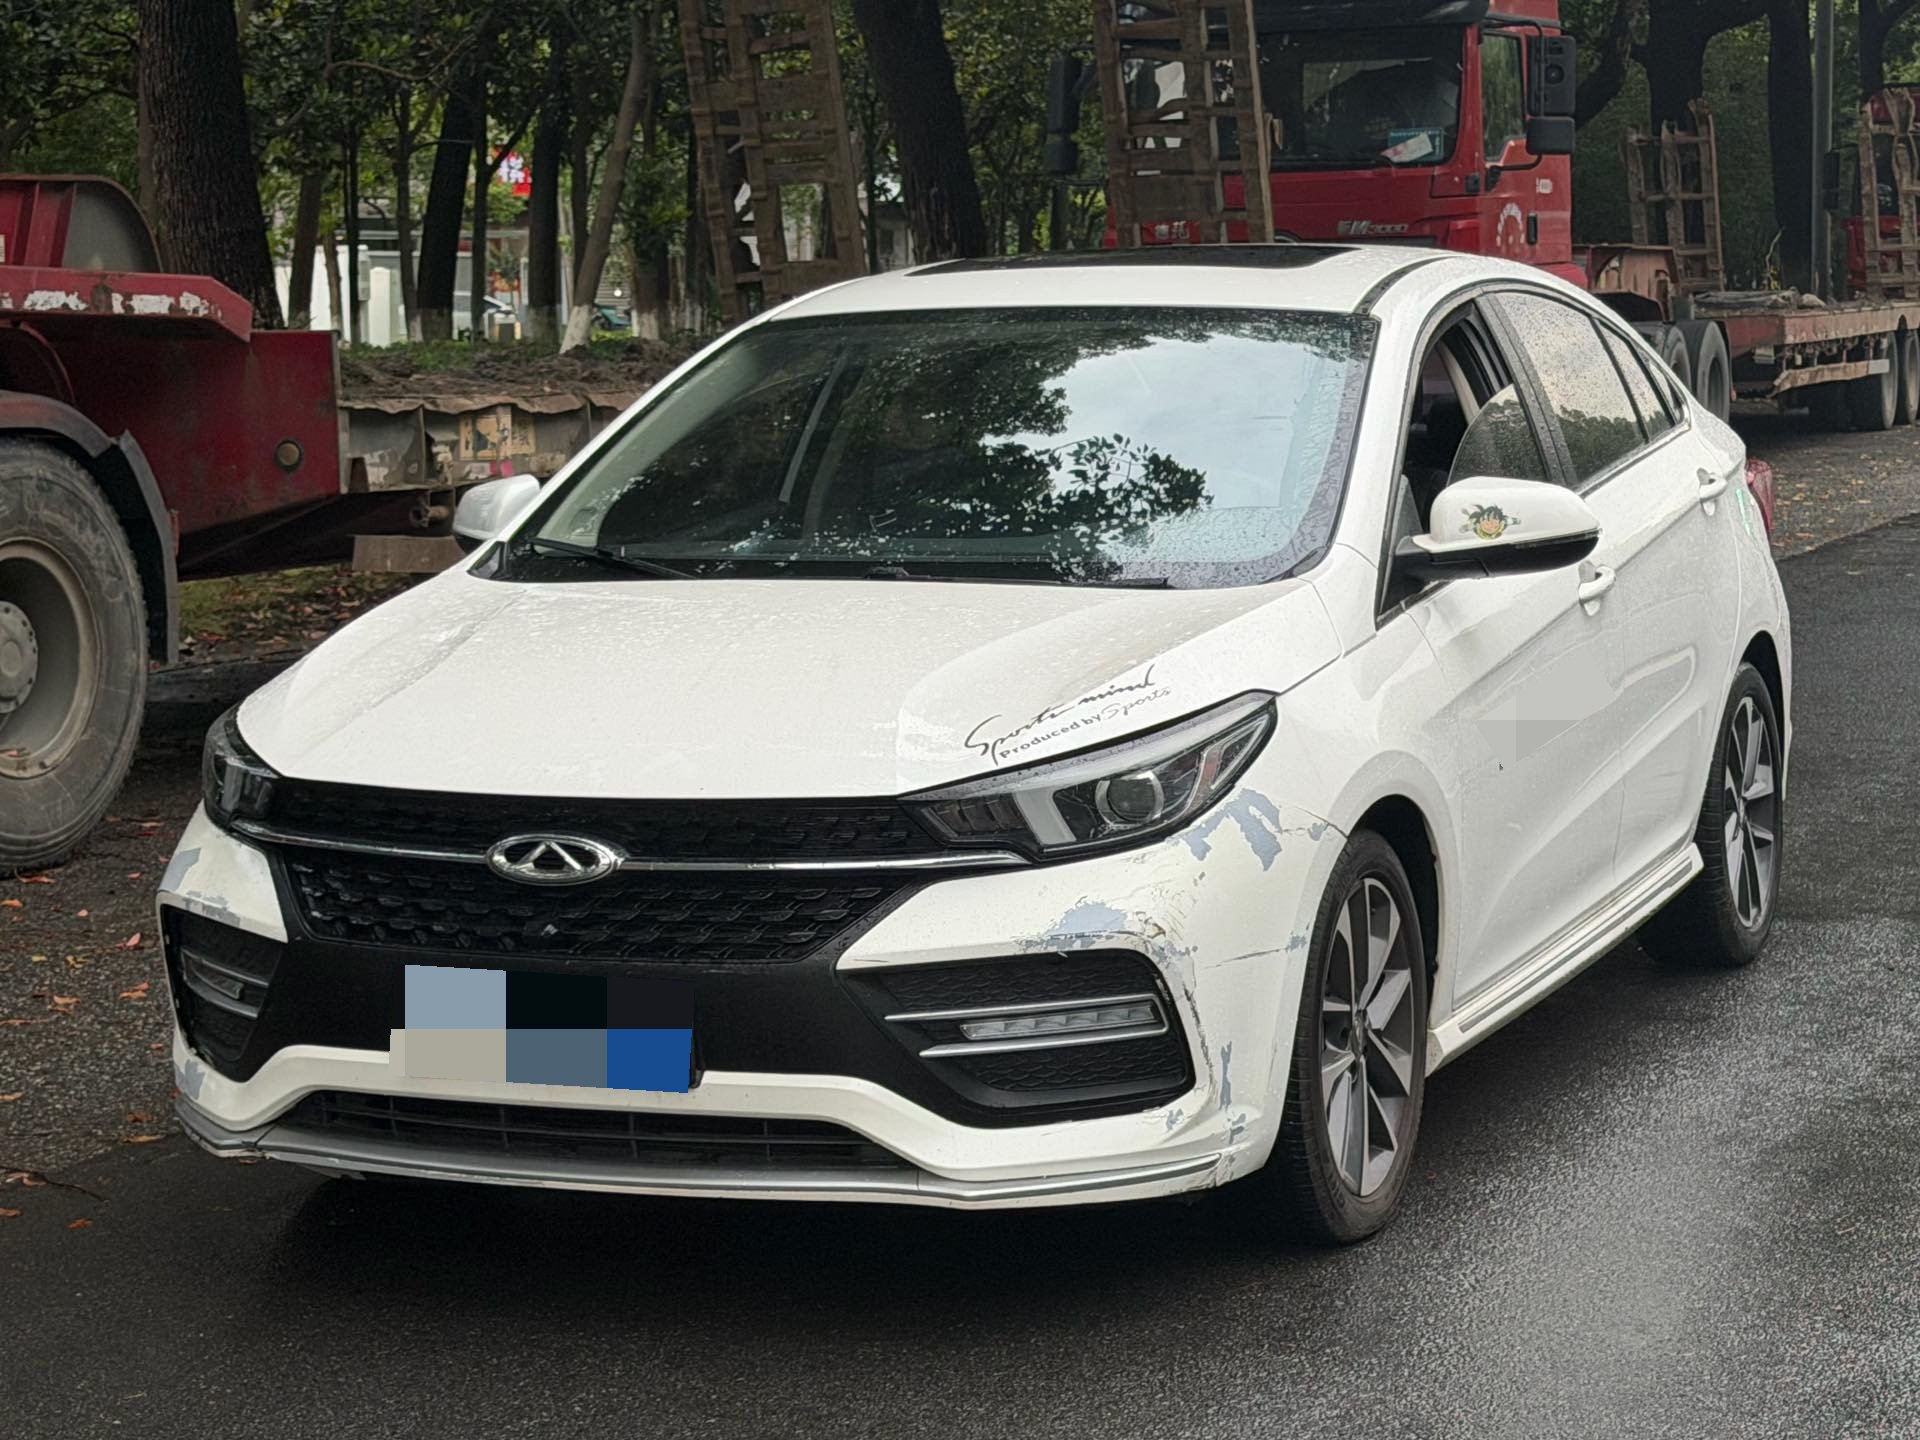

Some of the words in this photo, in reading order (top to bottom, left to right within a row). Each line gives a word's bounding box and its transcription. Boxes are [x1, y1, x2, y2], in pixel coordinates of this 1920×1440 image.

[1078, 663, 1156, 705] mind
[999, 721, 1080, 758] Produced
[1080, 714, 1101, 725] by
[1100, 687, 1171, 720] Sports
